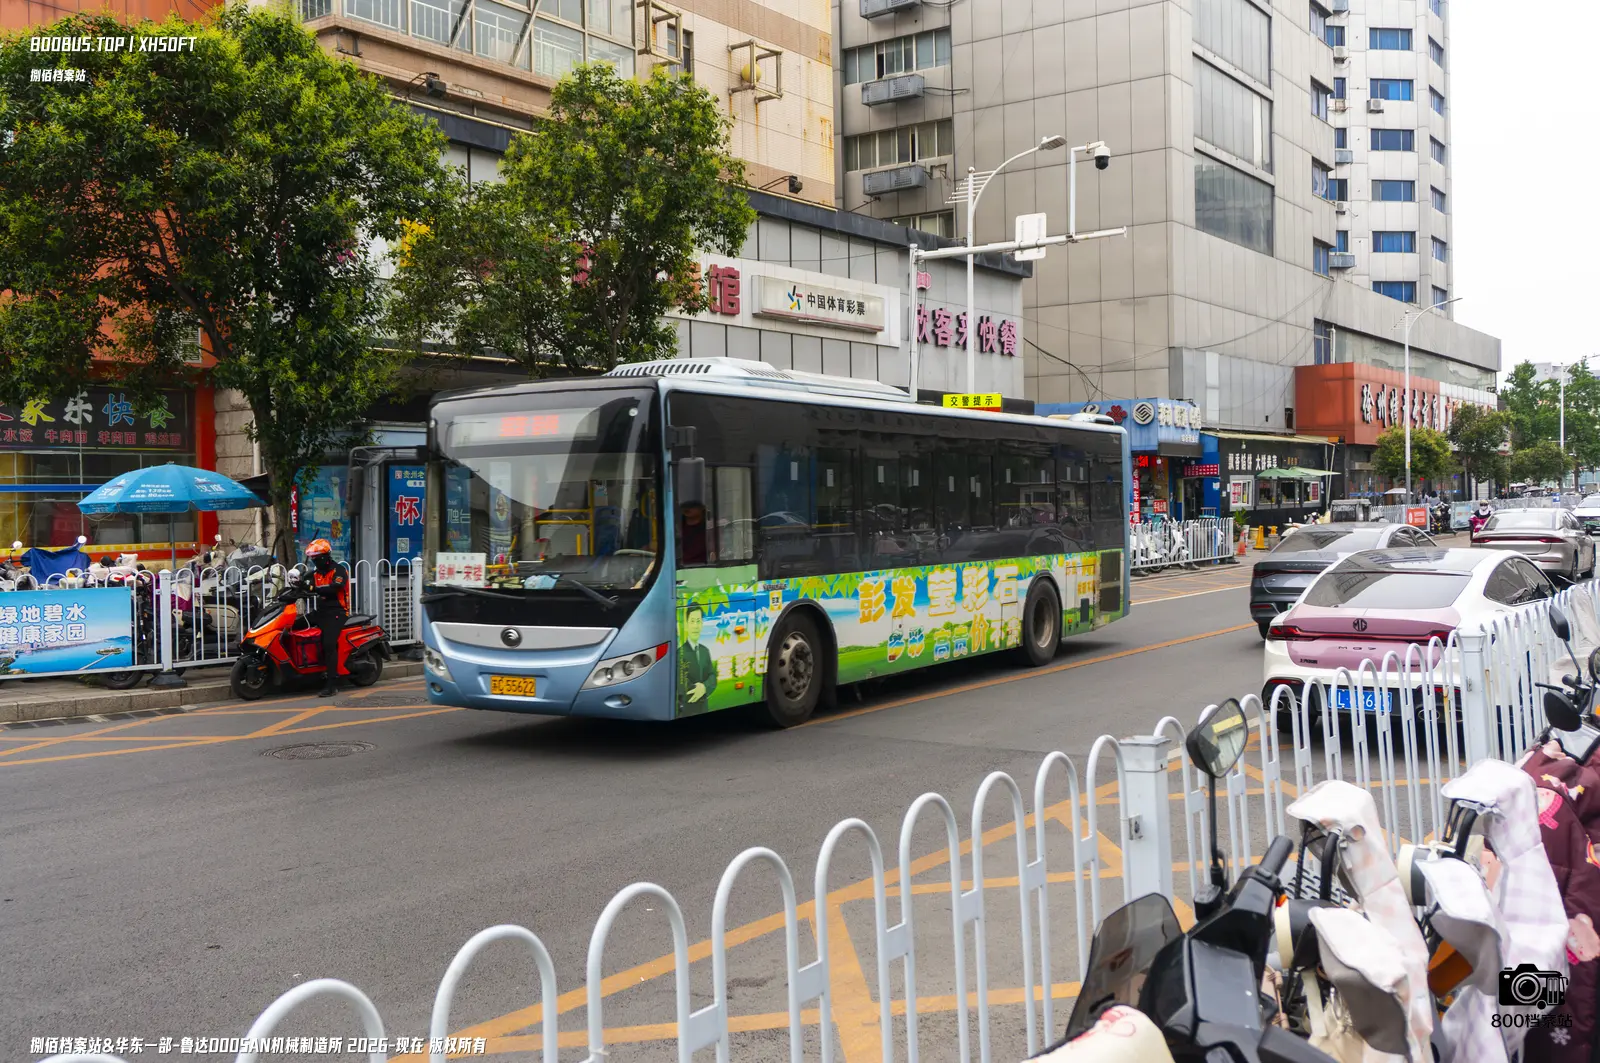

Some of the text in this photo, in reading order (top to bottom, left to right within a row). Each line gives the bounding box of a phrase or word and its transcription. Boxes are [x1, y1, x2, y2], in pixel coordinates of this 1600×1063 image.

[807, 292, 866, 316] 中国体育彩票
[951, 395, 993, 407] 交警提示
[45, 429, 88, 443] 牛肉面
[98, 431, 137, 445] 羊肉面
[858, 575, 917, 624] 彭发
[0, 603, 87, 625] 绿地碧水
[0, 623, 87, 644] 健康家园
[1353, 618, 1368, 633] MG
